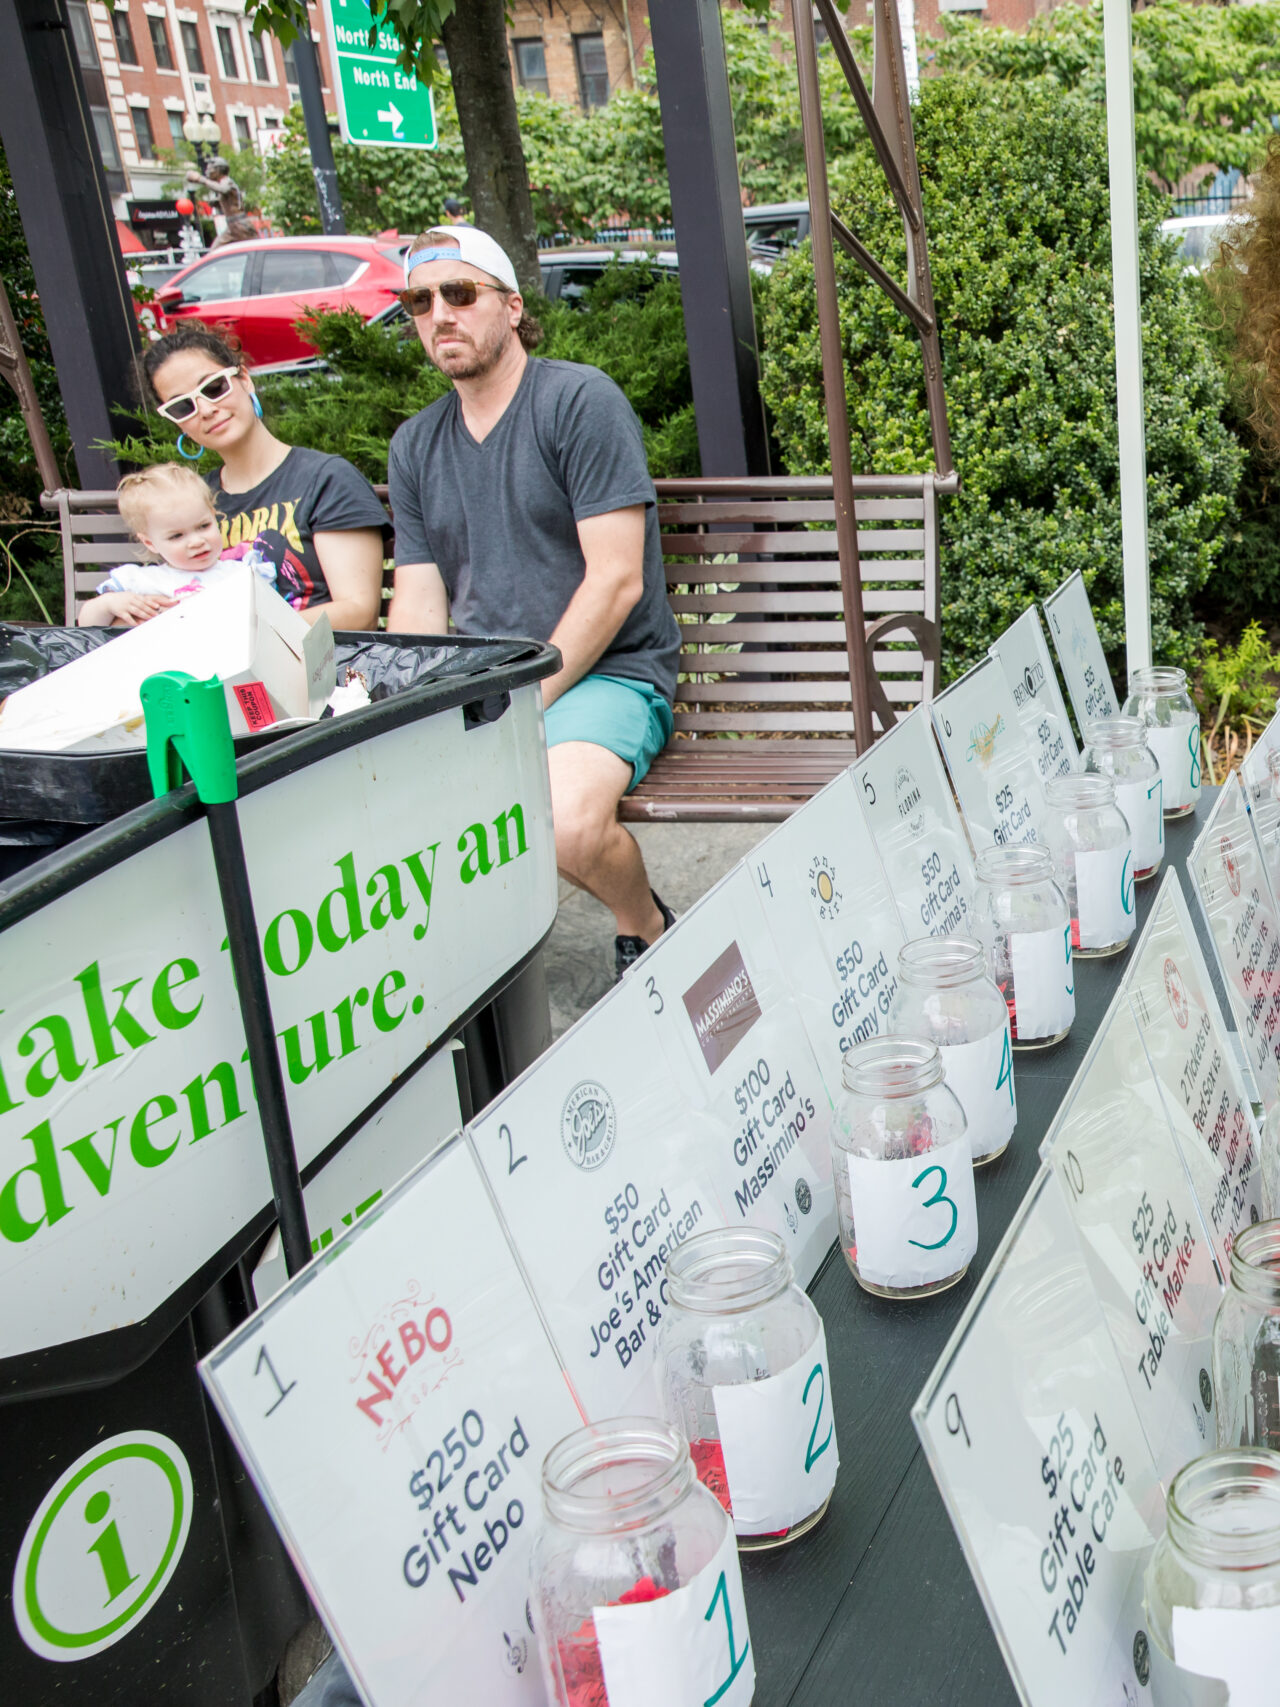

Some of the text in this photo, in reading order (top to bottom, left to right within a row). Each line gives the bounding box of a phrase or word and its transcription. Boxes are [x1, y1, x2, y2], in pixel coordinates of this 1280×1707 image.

[353, 66, 417, 91] North End
[247, 691, 262, 721] COUPON
[1013, 663, 1044, 707] BENCOTTO
[1084, 666, 1094, 687] $25
[1085, 680, 1106, 715] Gift Card
[247, 706, 258, 725] KEEP
[941, 713, 952, 738] 6
[1038, 720, 1050, 744] $25
[1039, 731, 1064, 775] Gift Card
[1055, 758, 1071, 776] otto
[1188, 724, 1200, 788] 8
[862, 772, 877, 805] 5
[995, 784, 1014, 813] $25
[993, 798, 1031, 846] Gift Card
[757, 862, 773, 898] 4
[921, 852, 941, 886] $50
[921, 864, 960, 926] Gift Card
[1121, 850, 1134, 915] 6
[1233, 887, 1260, 960] 2 Tickets to
[0, 960, 205, 1114] ake
[457, 803, 529, 884] an
[832, 951, 889, 1028] Gift Card
[836, 941, 863, 982] $50
[1242, 951, 1255, 991] Red
[1251, 940, 1263, 967] Sox
[645, 976, 664, 1015] 3
[696, 969, 749, 1038] MASSIMINO'S
[879, 977, 898, 1023] Girl
[996, 1027, 1014, 1107] 4
[1180, 1012, 1211, 1106] 2 Tickets to
[1257, 1031, 1270, 1071] July
[0, 969, 424, 1243] dvenure.
[733, 1070, 796, 1166] Gift Card
[735, 1059, 770, 1116] $100
[1192, 1096, 1208, 1136] Red
[1202, 1073, 1218, 1106] Sox
[499, 1123, 528, 1175] 2
[1208, 1090, 1230, 1156] Rangers
[734, 1098, 815, 1217] Massimino's
[1062, 1150, 1084, 1203] 10
[1210, 1168, 1231, 1234] Friday
[1224, 1130, 1239, 1175] June
[598, 1242, 634, 1291] Gift
[631, 1188, 671, 1248] Card
[604, 1183, 639, 1235] $50
[908, 1165, 958, 1250] 3
[1132, 1190, 1154, 1255] $25
[1223, 1226, 1236, 1258] Box
[1231, 1187, 1245, 1221] 102,
[1239, 1157, 1252, 1187] Row
[589, 1199, 703, 1358] Joe's American
[1135, 1199, 1177, 1325] Gift Card
[614, 1298, 662, 1369] Bar &
[1138, 1219, 1196, 1390] Table Market
[252, 1345, 297, 1418] 1
[356, 1307, 453, 1427] NEBO
[802, 1363, 833, 1474] 2
[945, 1393, 971, 1448] 9
[408, 1409, 485, 1511] $250
[1041, 1412, 1073, 1499] $25
[403, 1417, 530, 1590] Gift Card
[1040, 1412, 1108, 1594] Gift Card
[447, 1499, 525, 1603] Nebo
[1047, 1455, 1126, 1656] Table Cafe
[703, 1570, 749, 1707] 1
